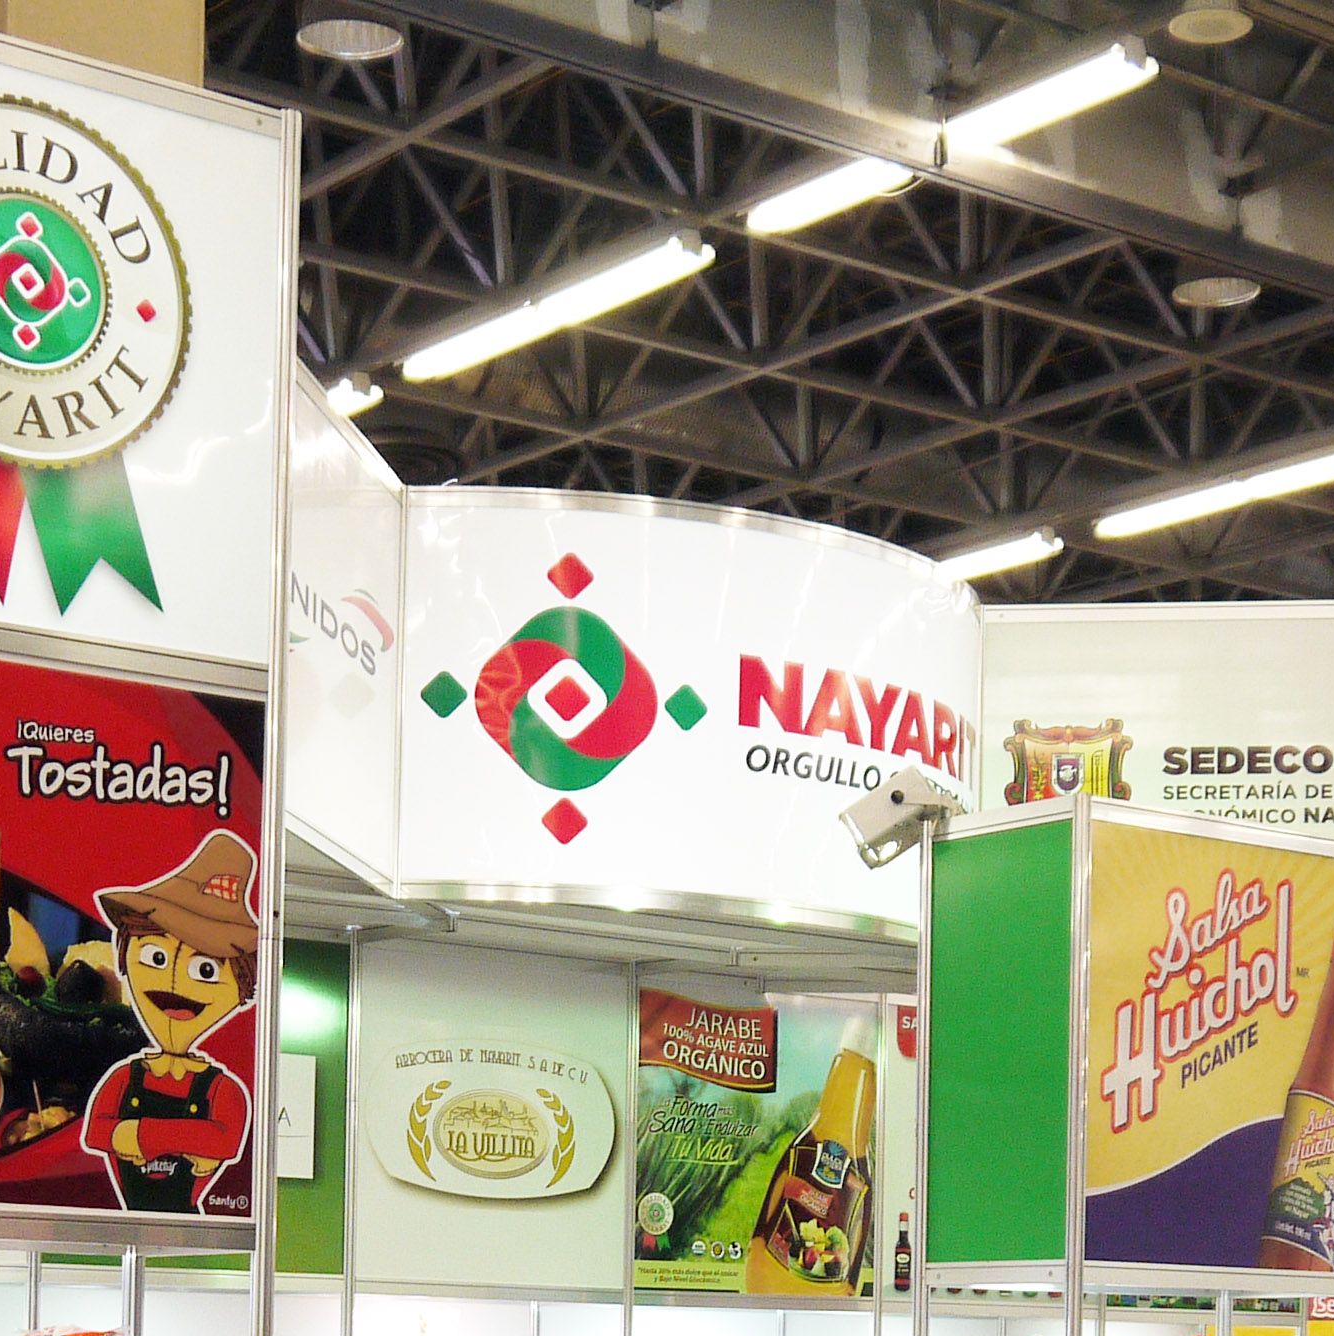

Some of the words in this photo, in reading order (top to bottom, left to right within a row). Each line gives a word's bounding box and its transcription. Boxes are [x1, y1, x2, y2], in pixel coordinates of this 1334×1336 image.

[738, 654, 976, 790] NAYARIT
[745, 744, 882, 791] ORGULLO
[1163, 745, 1334, 776] SEDECO
[7, 744, 231, 818] Tostadas!
[1163, 780, 1297, 800] SECRETARÍA
[1305, 783, 1333, 799] DE
[1145, 868, 1270, 991] Salsa
[1101, 878, 1298, 1133] Huichol
[662, 1022, 695, 1044] 100%
[696, 1035, 737, 1054] AGAVE
[738, 1043, 770, 1058] AZUL
[685, 1007, 763, 1041] JARABE
[460, 1048, 473, 1062] DE
[663, 1041, 766, 1080] ORGÁNICO
[1180, 1022, 1259, 1089] PICANTE
[648, 1111, 696, 1134] Sana
[669, 1095, 718, 1118] Forma
[696, 1138, 733, 1161] Vida
